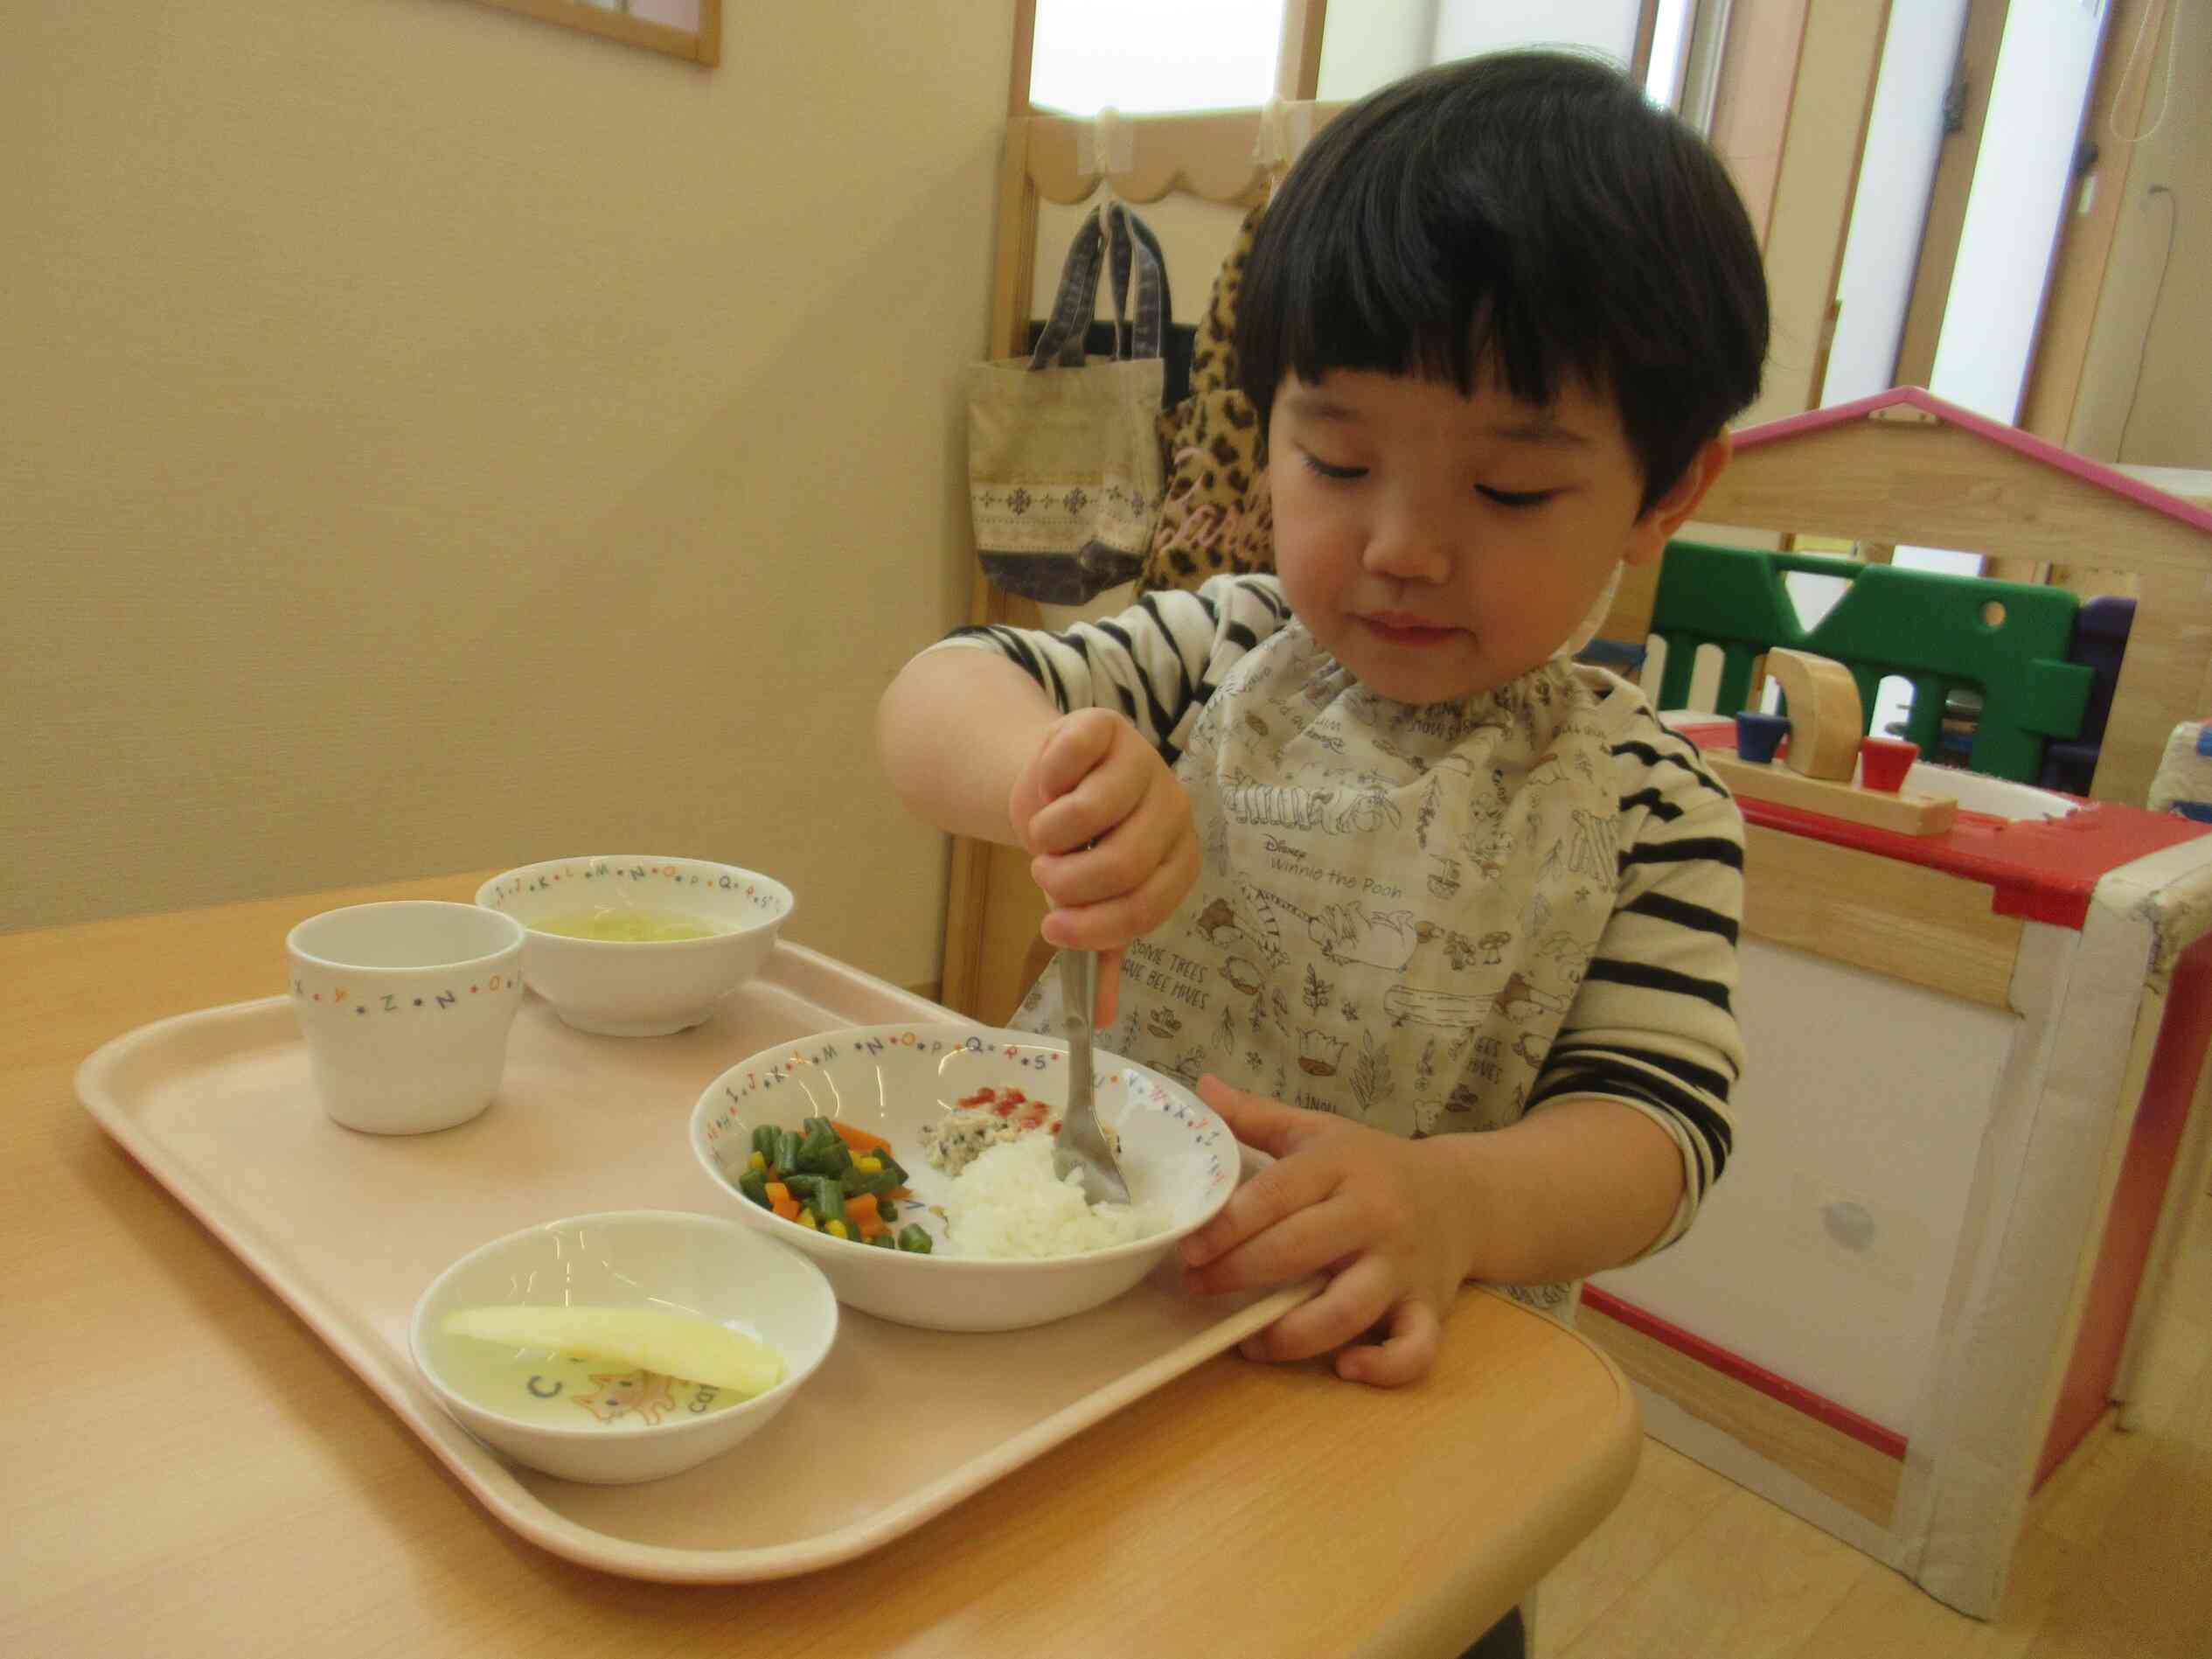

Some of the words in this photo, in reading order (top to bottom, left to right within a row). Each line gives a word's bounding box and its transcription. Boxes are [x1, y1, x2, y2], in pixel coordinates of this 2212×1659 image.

[1260, 833, 1307, 860] Disney
[1271, 858, 1323, 882] Winnie
[1329, 869, 1358, 889] the
[1362, 877, 1402, 899] Pooh
[1132, 938, 1166, 965] SOME
[1169, 953, 1208, 983] TREES
[1123, 958, 1147, 981] AVE
[1147, 971, 1175, 993] BEE
[1171, 980, 1211, 1010] HIVES
[526, 1375, 563, 1398] C
